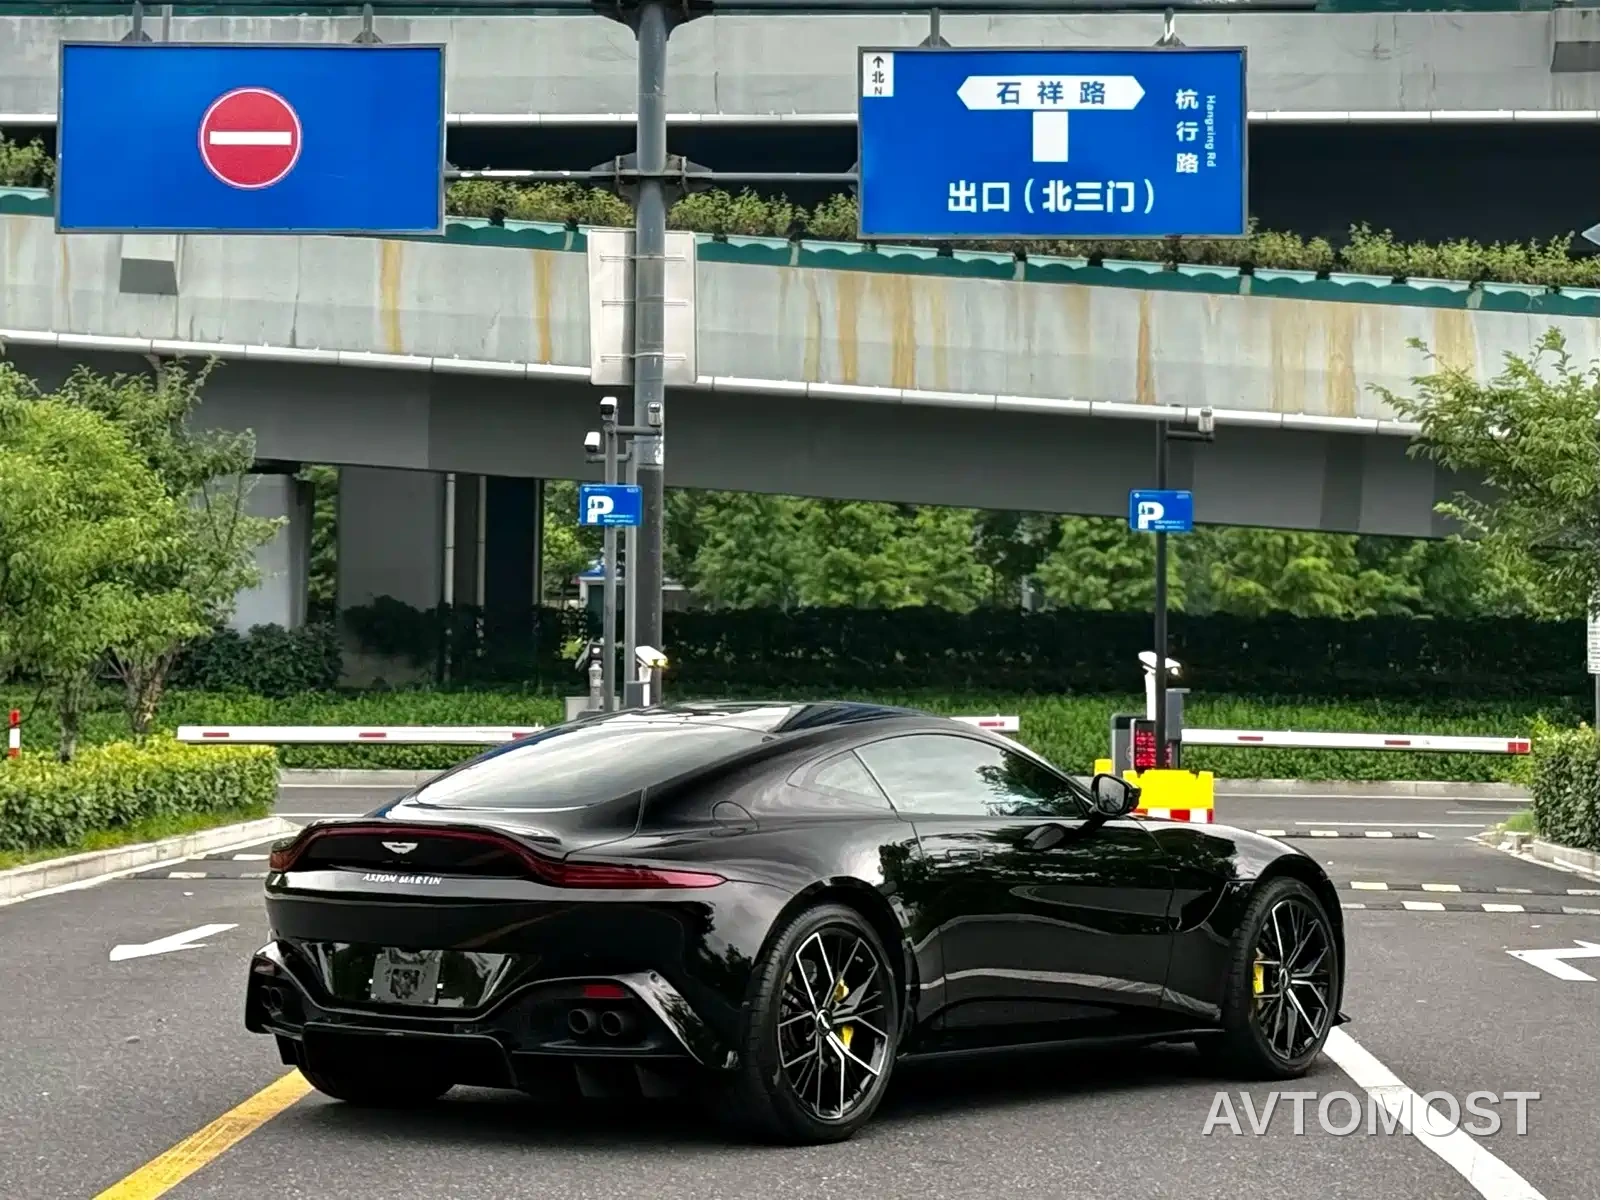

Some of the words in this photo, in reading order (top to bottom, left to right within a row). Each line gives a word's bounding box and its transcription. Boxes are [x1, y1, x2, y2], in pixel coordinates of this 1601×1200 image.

[872, 70, 885, 84] 北
[874, 86, 882, 96] N
[996, 80, 1107, 105] 石祥路
[1175, 88, 1200, 174] 杭行路
[1204, 95, 1216, 150] Hangxing
[1206, 152, 1217, 167] Rd
[587, 495, 614, 523] P
[1138, 501, 1164, 529] P
[362, 873, 398, 883] ASTON
[398, 875, 443, 885] MARTIN
